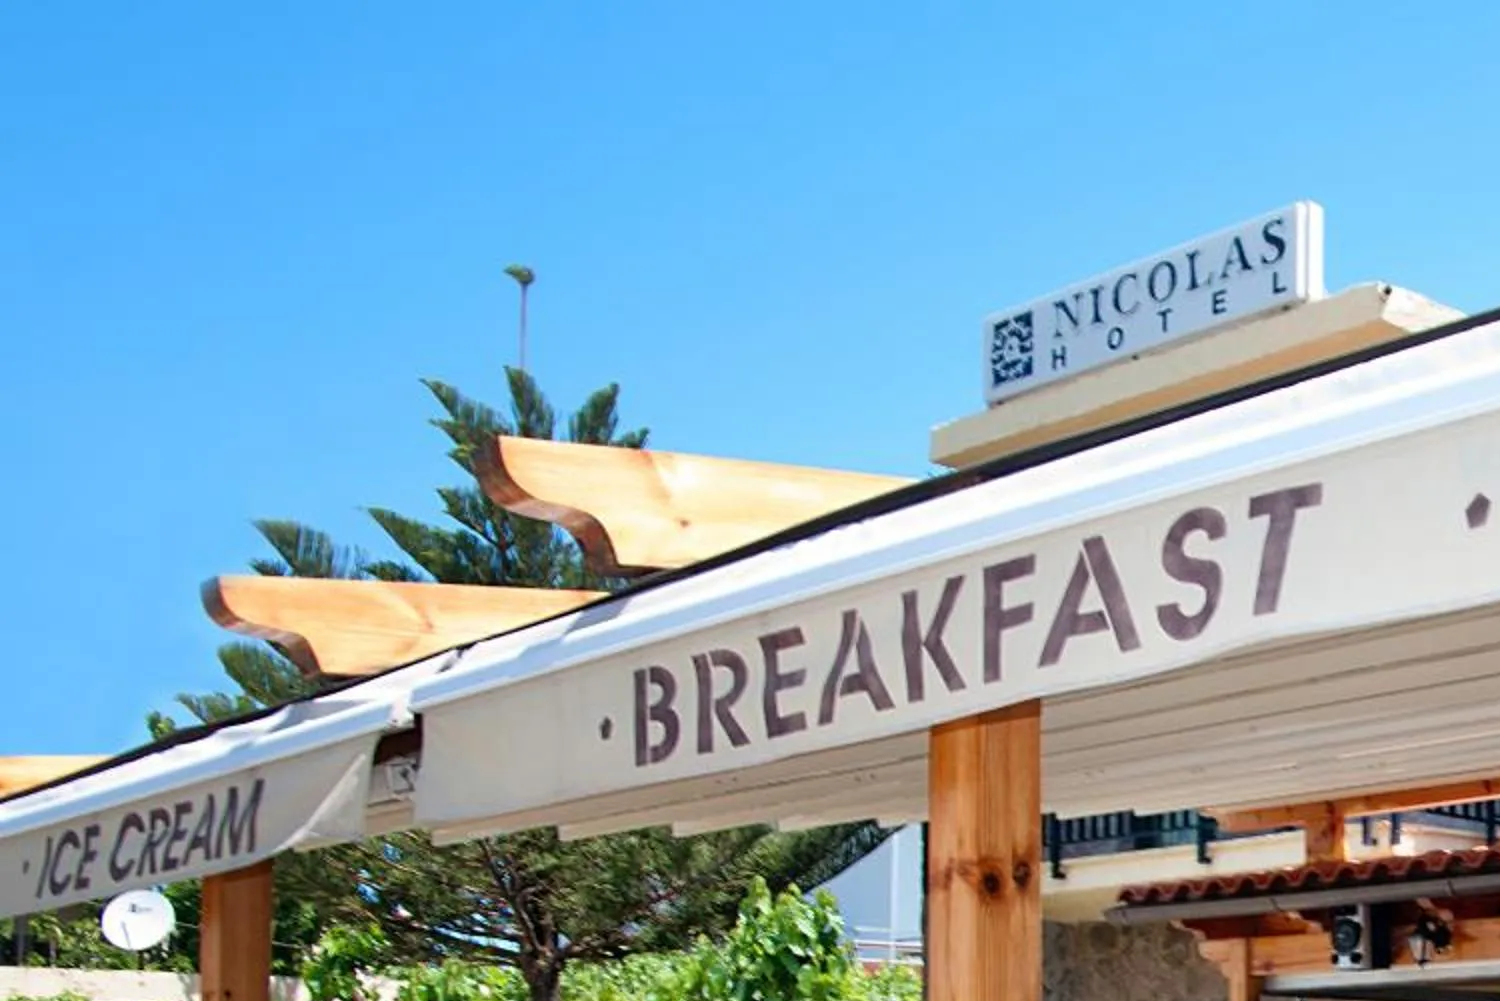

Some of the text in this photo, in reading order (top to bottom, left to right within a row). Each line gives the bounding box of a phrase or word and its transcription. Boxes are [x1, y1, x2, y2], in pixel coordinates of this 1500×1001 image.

[1051, 271, 1287, 370] HOTEL
[1052, 218, 1286, 337] NICOLAS
[633, 483, 1323, 768] BREAKFAST
[36, 779, 265, 898] ICE CREAM
